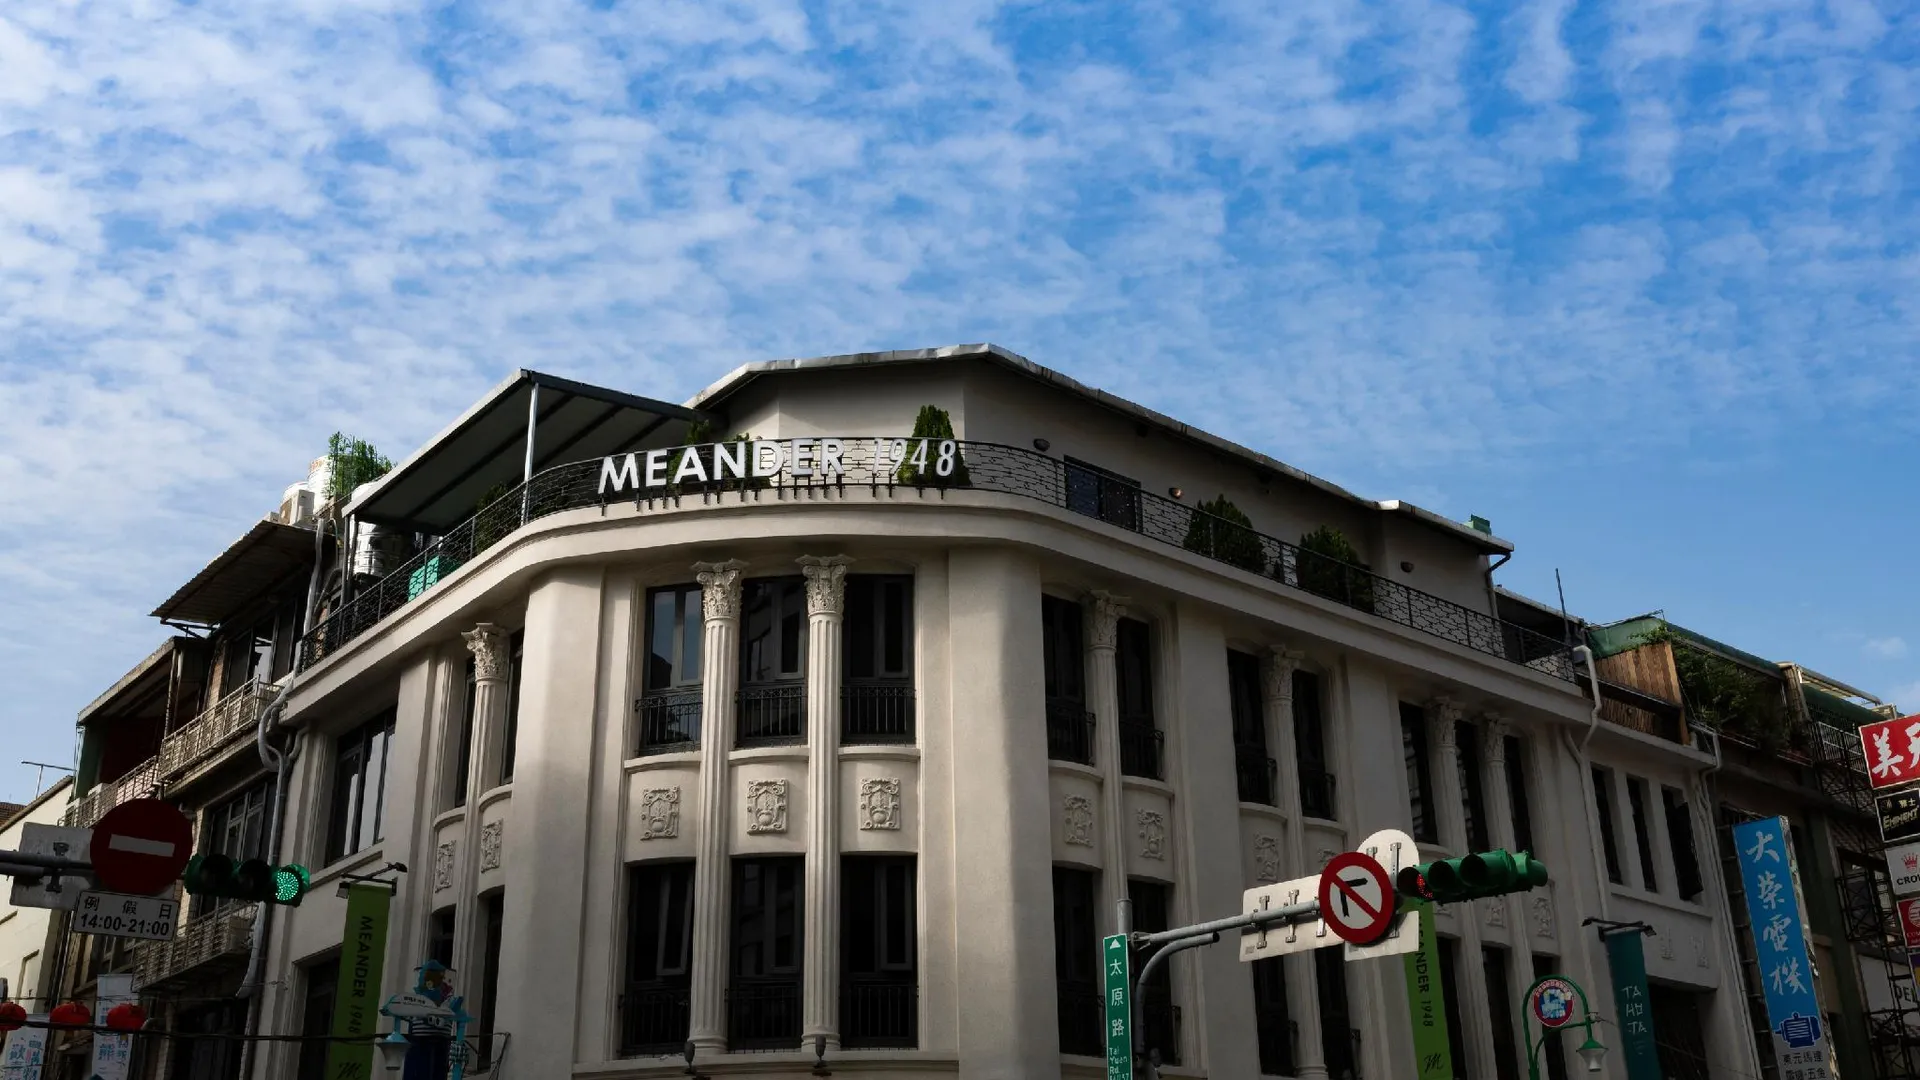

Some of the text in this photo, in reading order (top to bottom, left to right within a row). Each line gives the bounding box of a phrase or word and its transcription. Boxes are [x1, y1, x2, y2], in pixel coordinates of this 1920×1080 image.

[598, 437, 957, 494] MEANDER 1948
[84, 896, 172, 920] 例假日
[81, 913, 170, 936] 14:00-21:00
[352, 916, 373, 998] MEANDER
[1110, 958, 1125, 1038] 太原路
[1420, 1000, 1434, 1027] 1948
[1109, 1045, 1120, 1056] Tai
[1110, 1056, 1128, 1065] Yuan
